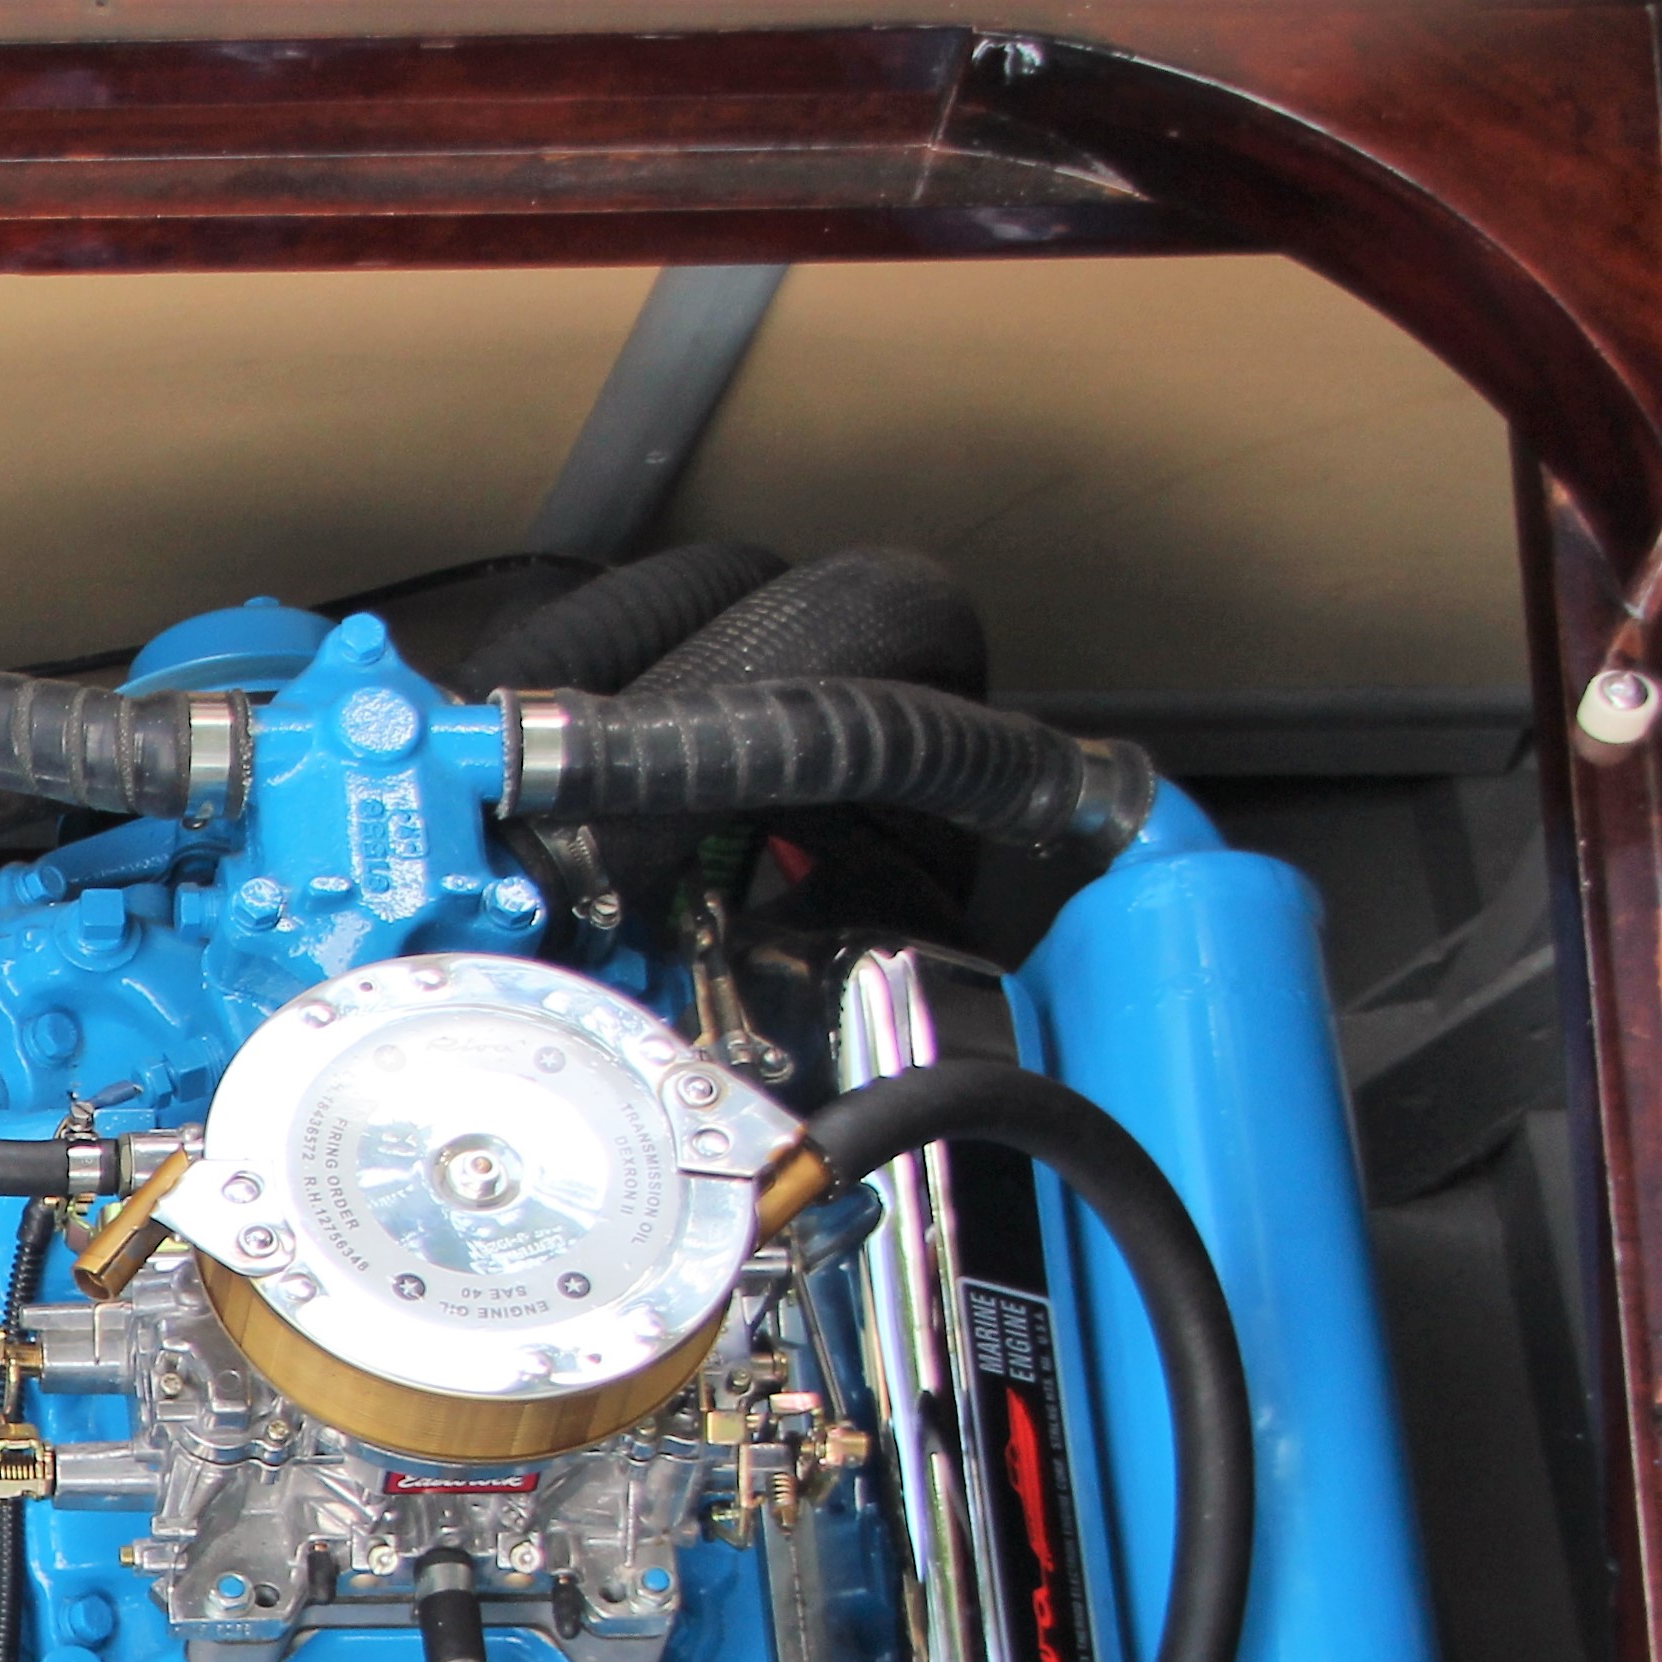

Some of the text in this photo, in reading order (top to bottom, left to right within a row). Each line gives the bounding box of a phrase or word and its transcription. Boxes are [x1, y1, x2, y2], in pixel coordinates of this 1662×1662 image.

[325, 1117, 360, 1230] FIRING ORDER
[614, 1135, 638, 1200] DEXRON
[620, 1103, 662, 1244] TRANSMISSION OIL
[461, 1285, 527, 1300] SAE 40
[477, 1300, 549, 1319] ENGINE
[969, 1291, 1006, 1376] MARINE
[1000, 1300, 1037, 1384] ENGINE
